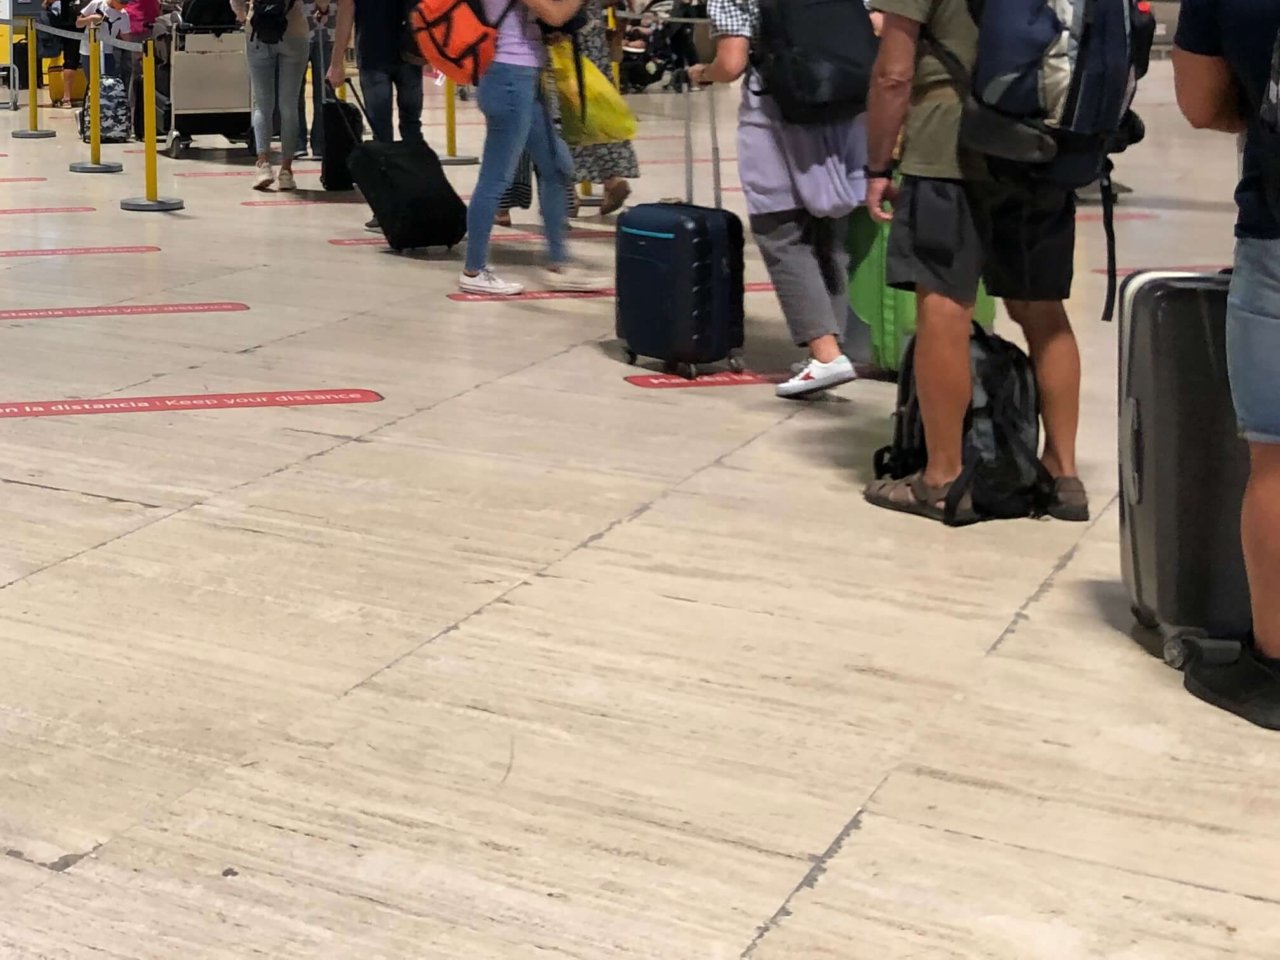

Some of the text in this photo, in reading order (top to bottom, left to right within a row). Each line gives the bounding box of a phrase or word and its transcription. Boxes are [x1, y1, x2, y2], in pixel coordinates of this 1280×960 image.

[24, 405, 45, 413] la
[51, 400, 150, 411] distancia
[165, 398, 218, 406] Keep
[223, 395, 268, 405] your
[275, 392, 362, 402] distance
